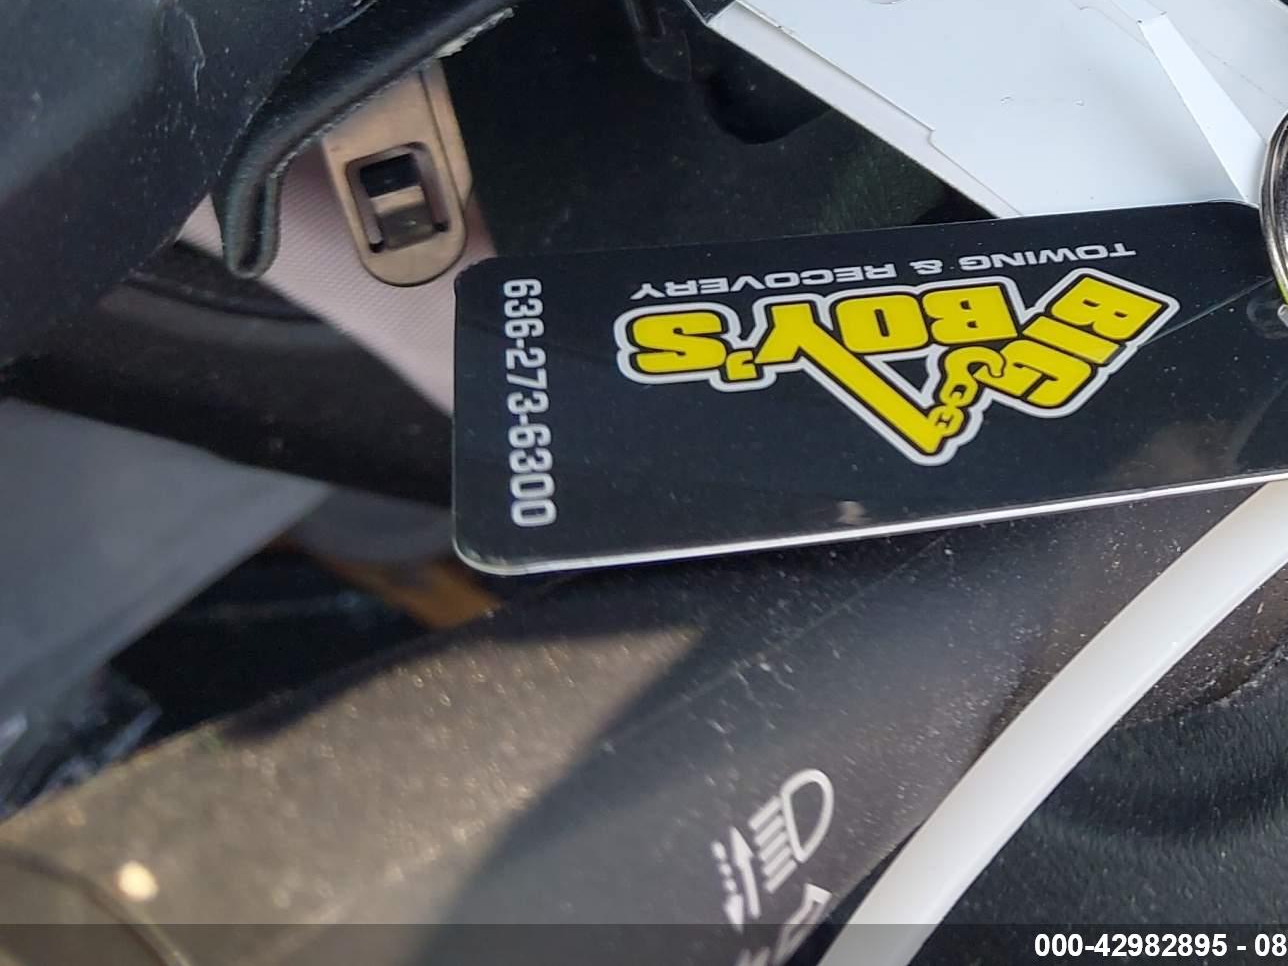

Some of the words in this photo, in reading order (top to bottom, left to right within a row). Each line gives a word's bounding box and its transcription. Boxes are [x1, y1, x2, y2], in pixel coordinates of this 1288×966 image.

[630, 263, 897, 300] RECOVERY
[909, 259, 943, 275] &
[959, 242, 1137, 271] TOWING
[628, 282, 1020, 448] BOY'S
[972, 272, 1170, 413] BIG
[503, 278, 557, 527] 636-273-6300
